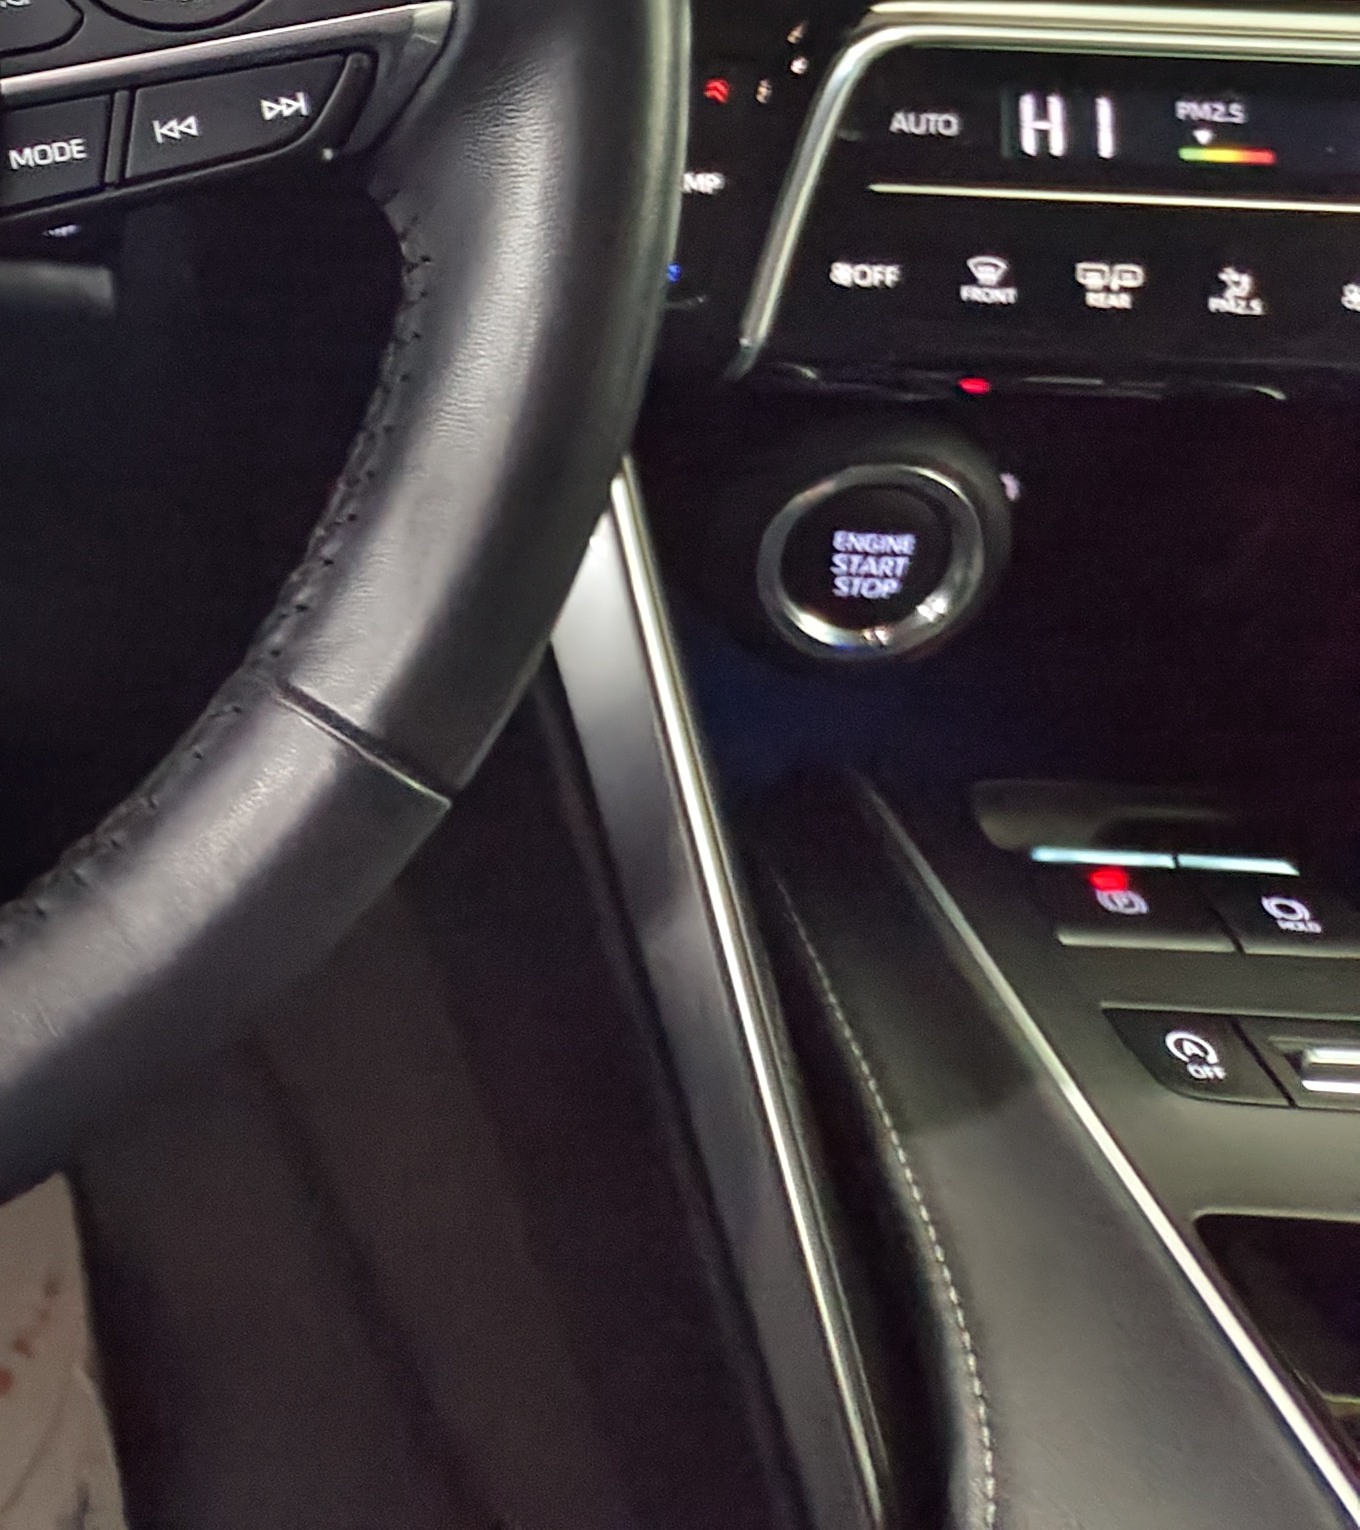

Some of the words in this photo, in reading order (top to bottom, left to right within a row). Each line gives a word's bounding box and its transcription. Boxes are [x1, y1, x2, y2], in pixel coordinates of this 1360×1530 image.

[889, 110, 961, 139] AUTO
[1019, 91, 1118, 159] HI
[8, 137, 87, 170] MODE
[682, 169, 726, 195] MP
[855, 262, 901, 289] OFF
[959, 284, 1016, 306] FRONT
[1085, 291, 1132, 310] REAR
[831, 530, 916, 556] ENGINE
[829, 554, 910, 578] START
[831, 577, 901, 600] STOP
[1187, 1061, 1227, 1082] OFF
